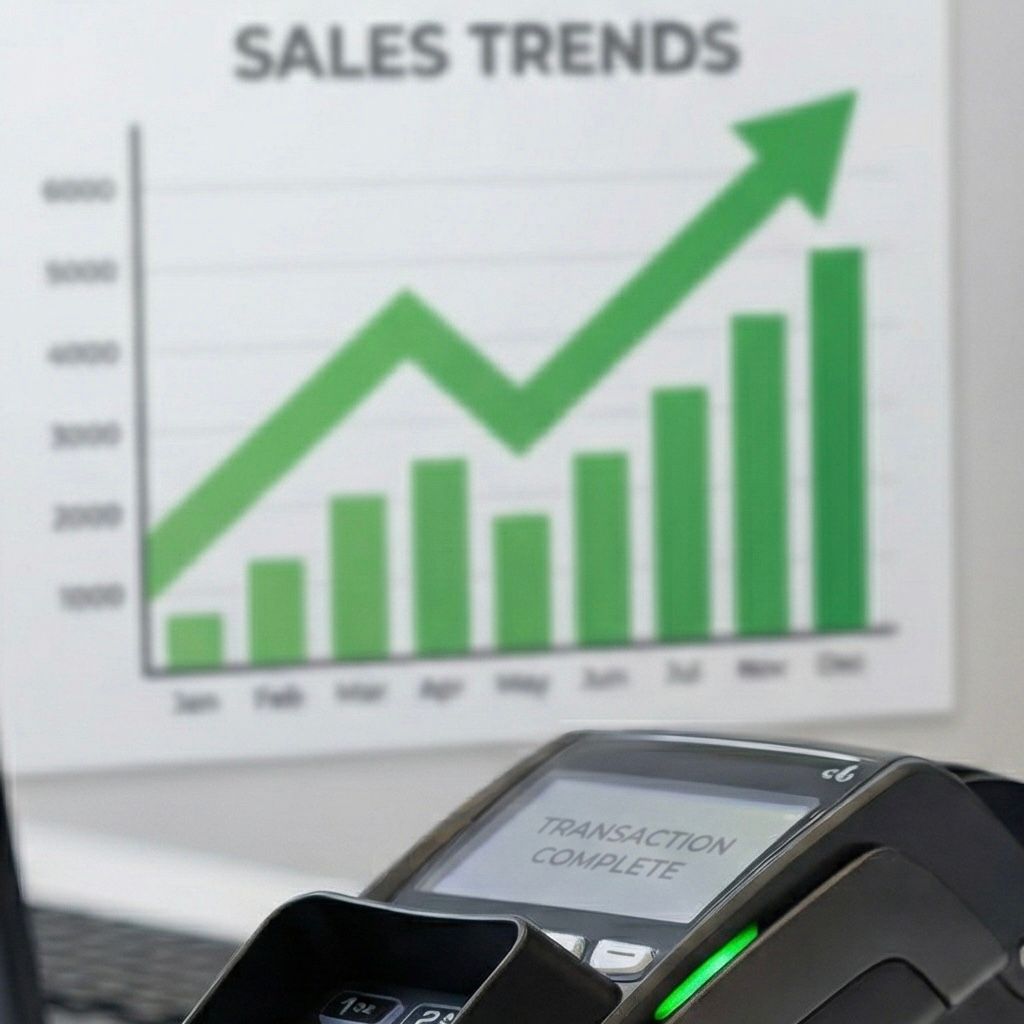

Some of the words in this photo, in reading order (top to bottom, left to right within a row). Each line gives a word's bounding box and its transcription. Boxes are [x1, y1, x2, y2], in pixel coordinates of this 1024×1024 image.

[234, 22, 451, 82] SALES
[468, 19, 741, 77] TRENDS
[537, 816, 737, 856] TRANSACTION
[531, 846, 687, 880] COMPLETE
[339, 997, 358, 1016] 1
